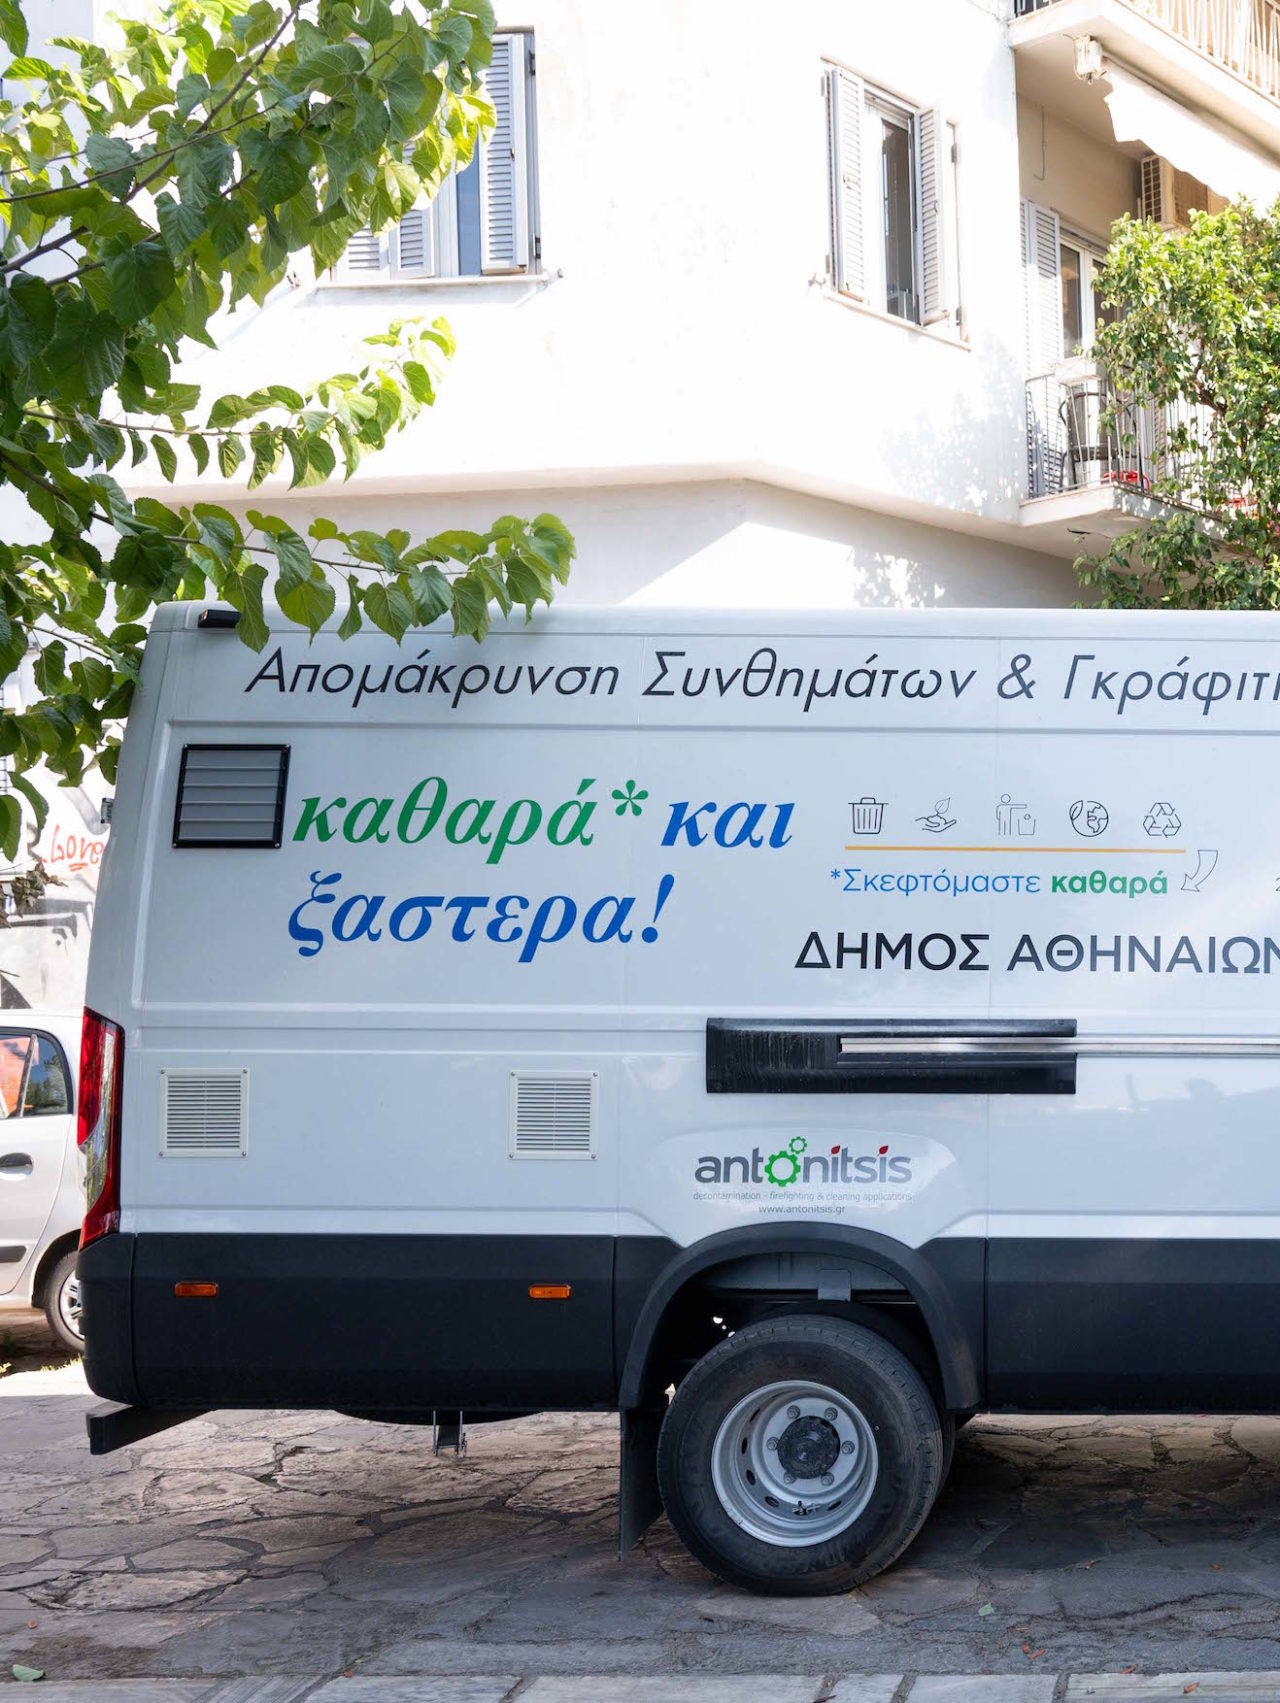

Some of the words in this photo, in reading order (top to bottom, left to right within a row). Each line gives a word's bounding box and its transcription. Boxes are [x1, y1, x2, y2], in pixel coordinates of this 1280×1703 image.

[243, 646, 619, 709] Απομάκρυνση
[641, 647, 977, 713] Συνθημάτων
[996, 653, 1036, 700] &
[660, 801, 796, 849] και
[1051, 869, 1168, 899] καθαρά
[287, 870, 675, 964] ξαστερα!
[794, 931, 990, 971] ΔΗΜΟΣ
[694, 1143, 913, 1187] antonitsis
[758, 1204, 846, 1215] www.antonitsis.gr
